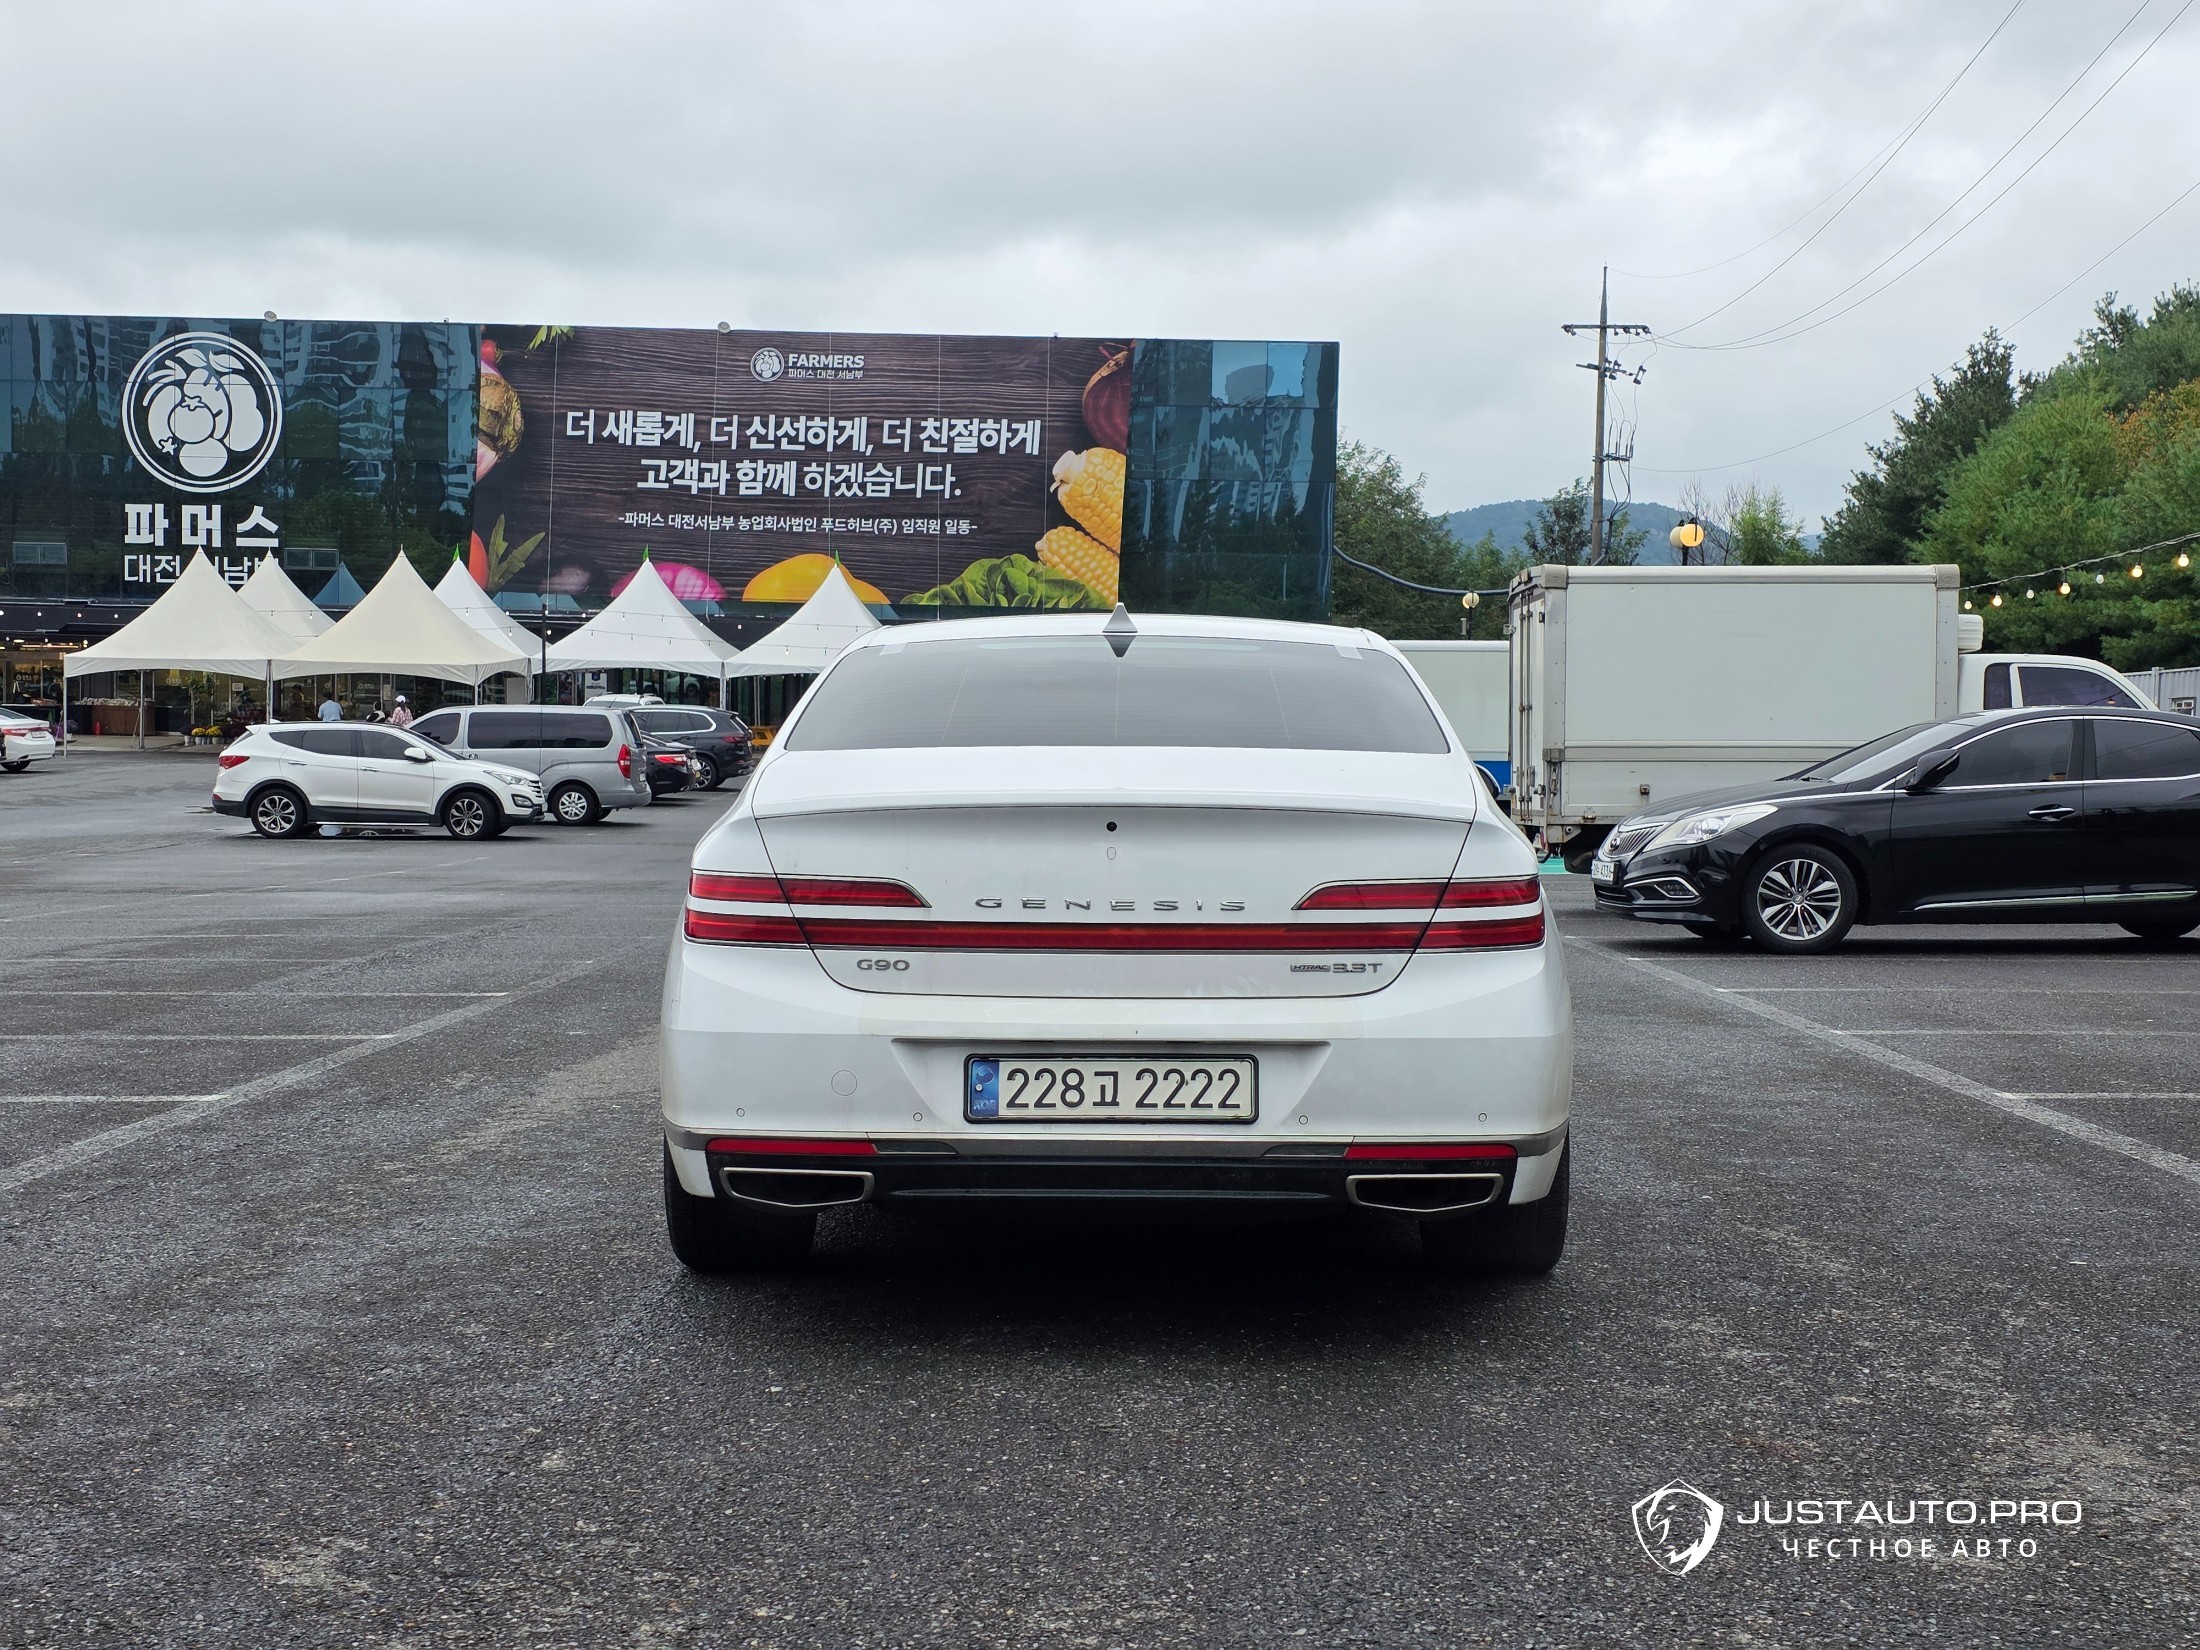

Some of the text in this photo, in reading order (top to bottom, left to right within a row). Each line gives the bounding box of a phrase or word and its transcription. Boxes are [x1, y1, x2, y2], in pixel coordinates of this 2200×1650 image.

[788, 353, 865, 369] FARMERS
[787, 368, 864, 380] 파머스 대전 서남부
[566, 408, 1041, 456] 더 새롭게, 더 신선하게, 더 친절하게
[636, 458, 962, 499] 고객과 함께 하겠습니다.
[124, 503, 279, 548] 파머스
[668, 513, 735, 531] 대전서남부
[737, 515, 817, 532] 농업회사법인
[820, 517, 898, 535] 푸드허브(주)
[901, 518, 941, 534] 임직원
[975, 897, 1246, 912] GENESIS
[856, 959, 910, 971] G90
[1292, 963, 1383, 973] HTRAC 3.3T
